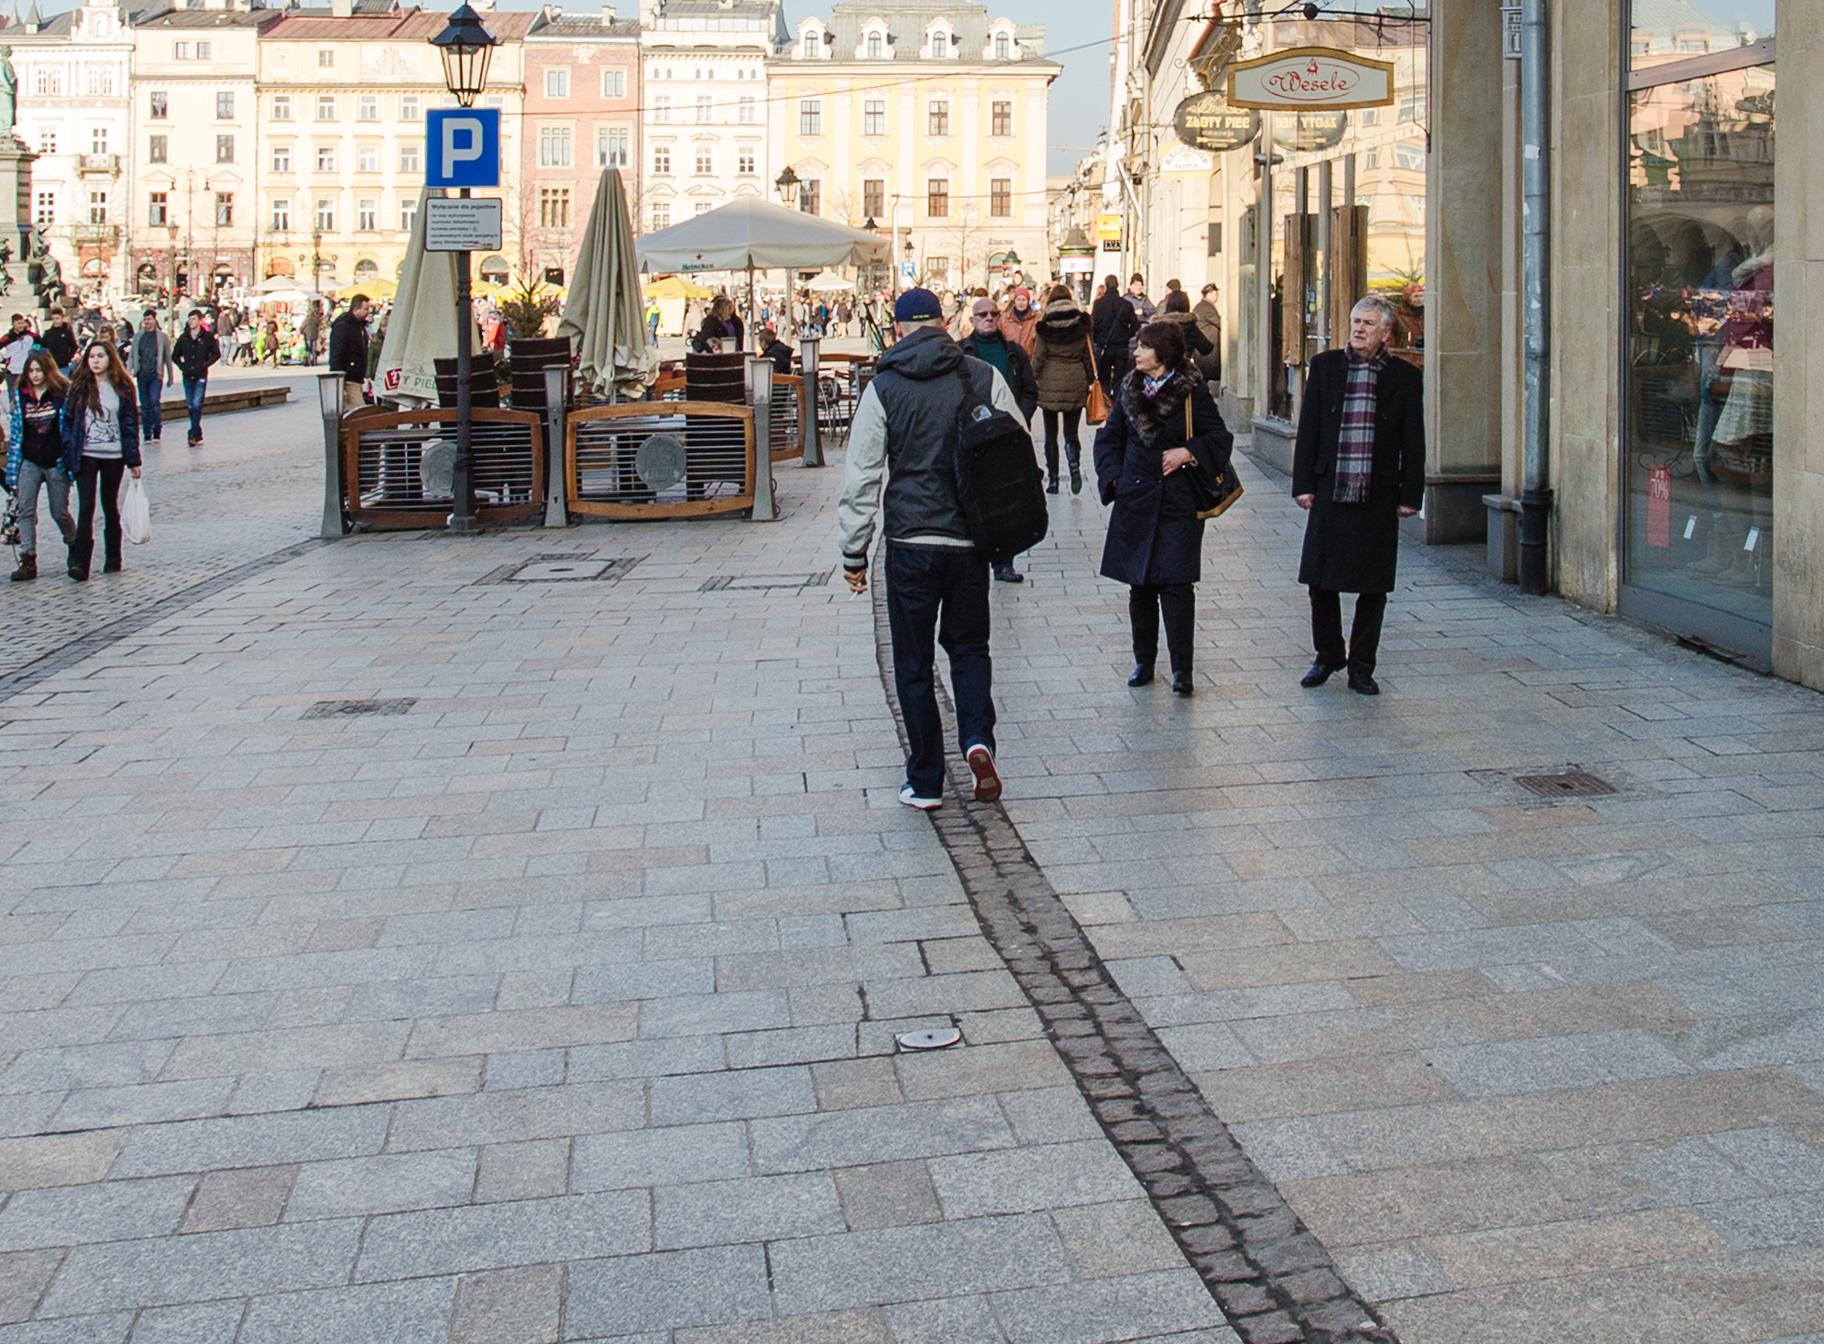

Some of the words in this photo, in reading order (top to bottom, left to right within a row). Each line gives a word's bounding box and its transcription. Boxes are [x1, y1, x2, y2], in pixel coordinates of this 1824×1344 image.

[1269, 71, 1347, 92] Wesele
[442, 118, 483, 178] P
[1650, 479, 1669, 500] 70%
